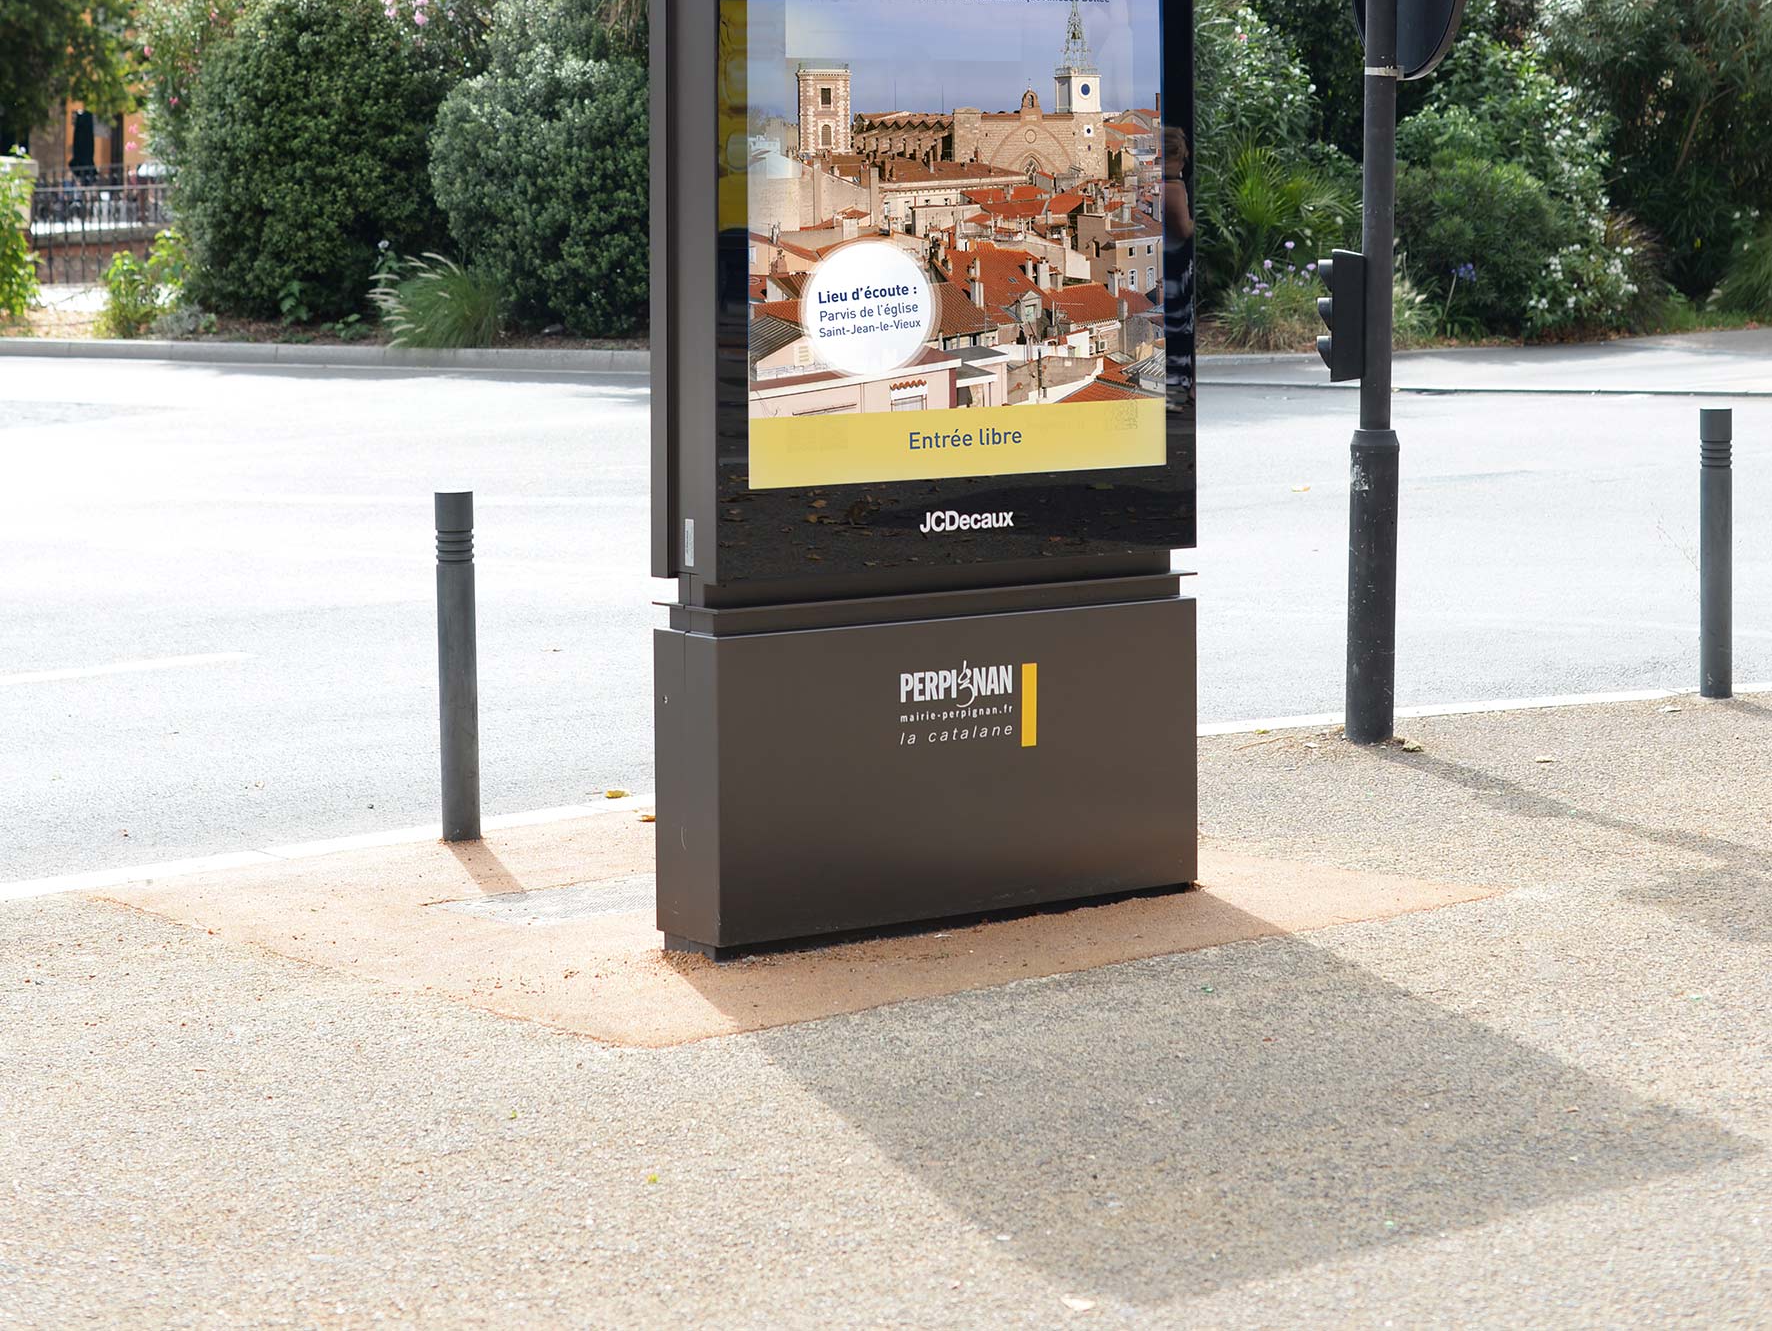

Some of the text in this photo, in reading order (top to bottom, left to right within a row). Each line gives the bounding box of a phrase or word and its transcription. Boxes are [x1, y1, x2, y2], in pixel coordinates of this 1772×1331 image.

[818, 291, 848, 304] Lieu
[852, 285, 909, 301] d'écoute
[820, 302, 919, 322] Parvis de l'église
[819, 319, 921, 338] Saint-Jean-le-Vieux
[909, 427, 1022, 449] Entrée libre
[919, 510, 1014, 533] JCDecaux
[900, 704, 1013, 723] mairie-perpignan.fr
[900, 725, 1013, 745] la catalane
